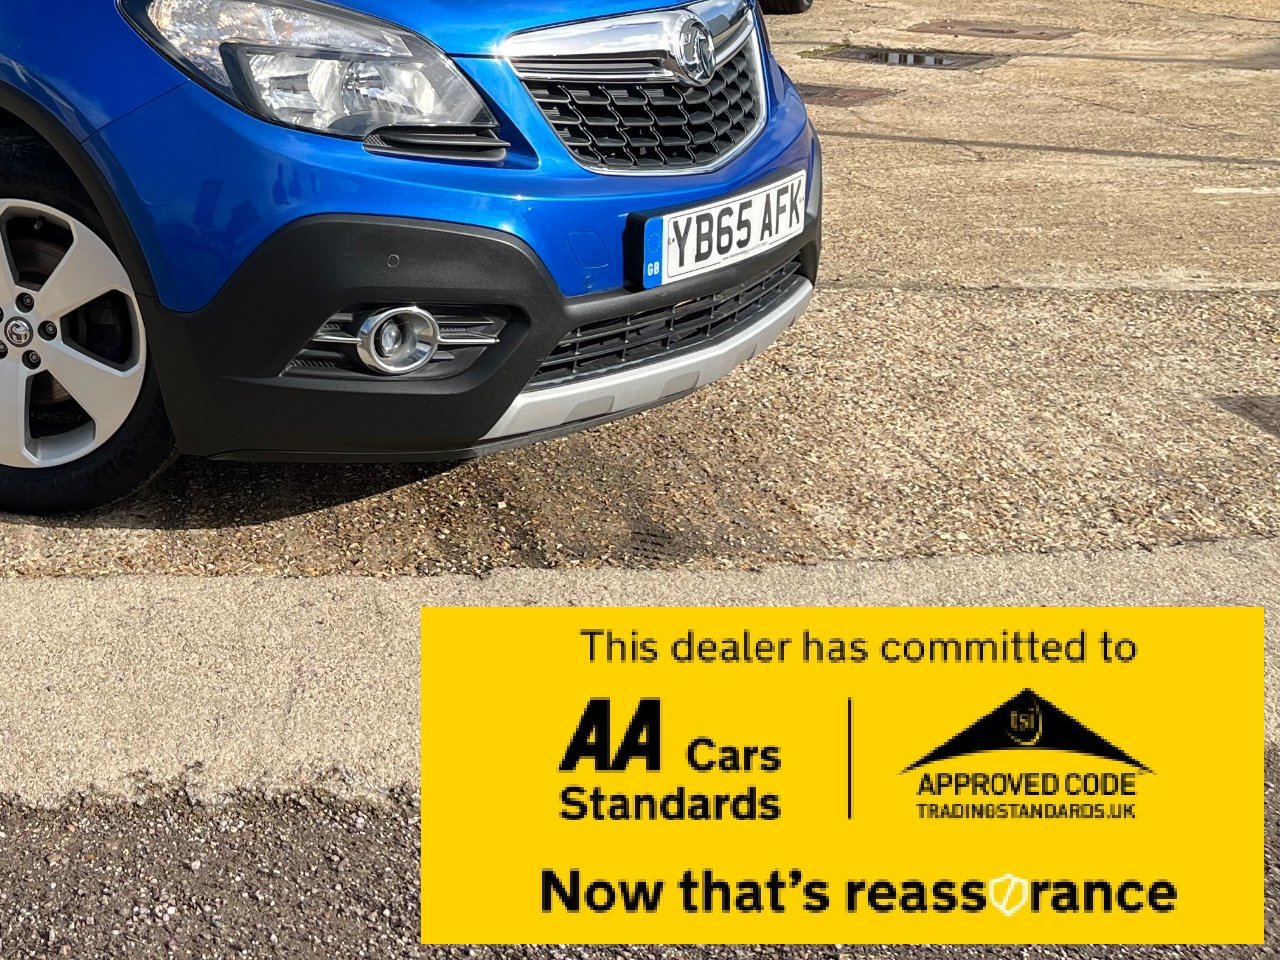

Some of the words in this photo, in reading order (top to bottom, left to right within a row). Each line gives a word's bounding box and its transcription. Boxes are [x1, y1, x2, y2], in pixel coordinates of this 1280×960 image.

[673, 199, 753, 268] YB65
[760, 179, 803, 242] AFK
[647, 261, 660, 277] GB
